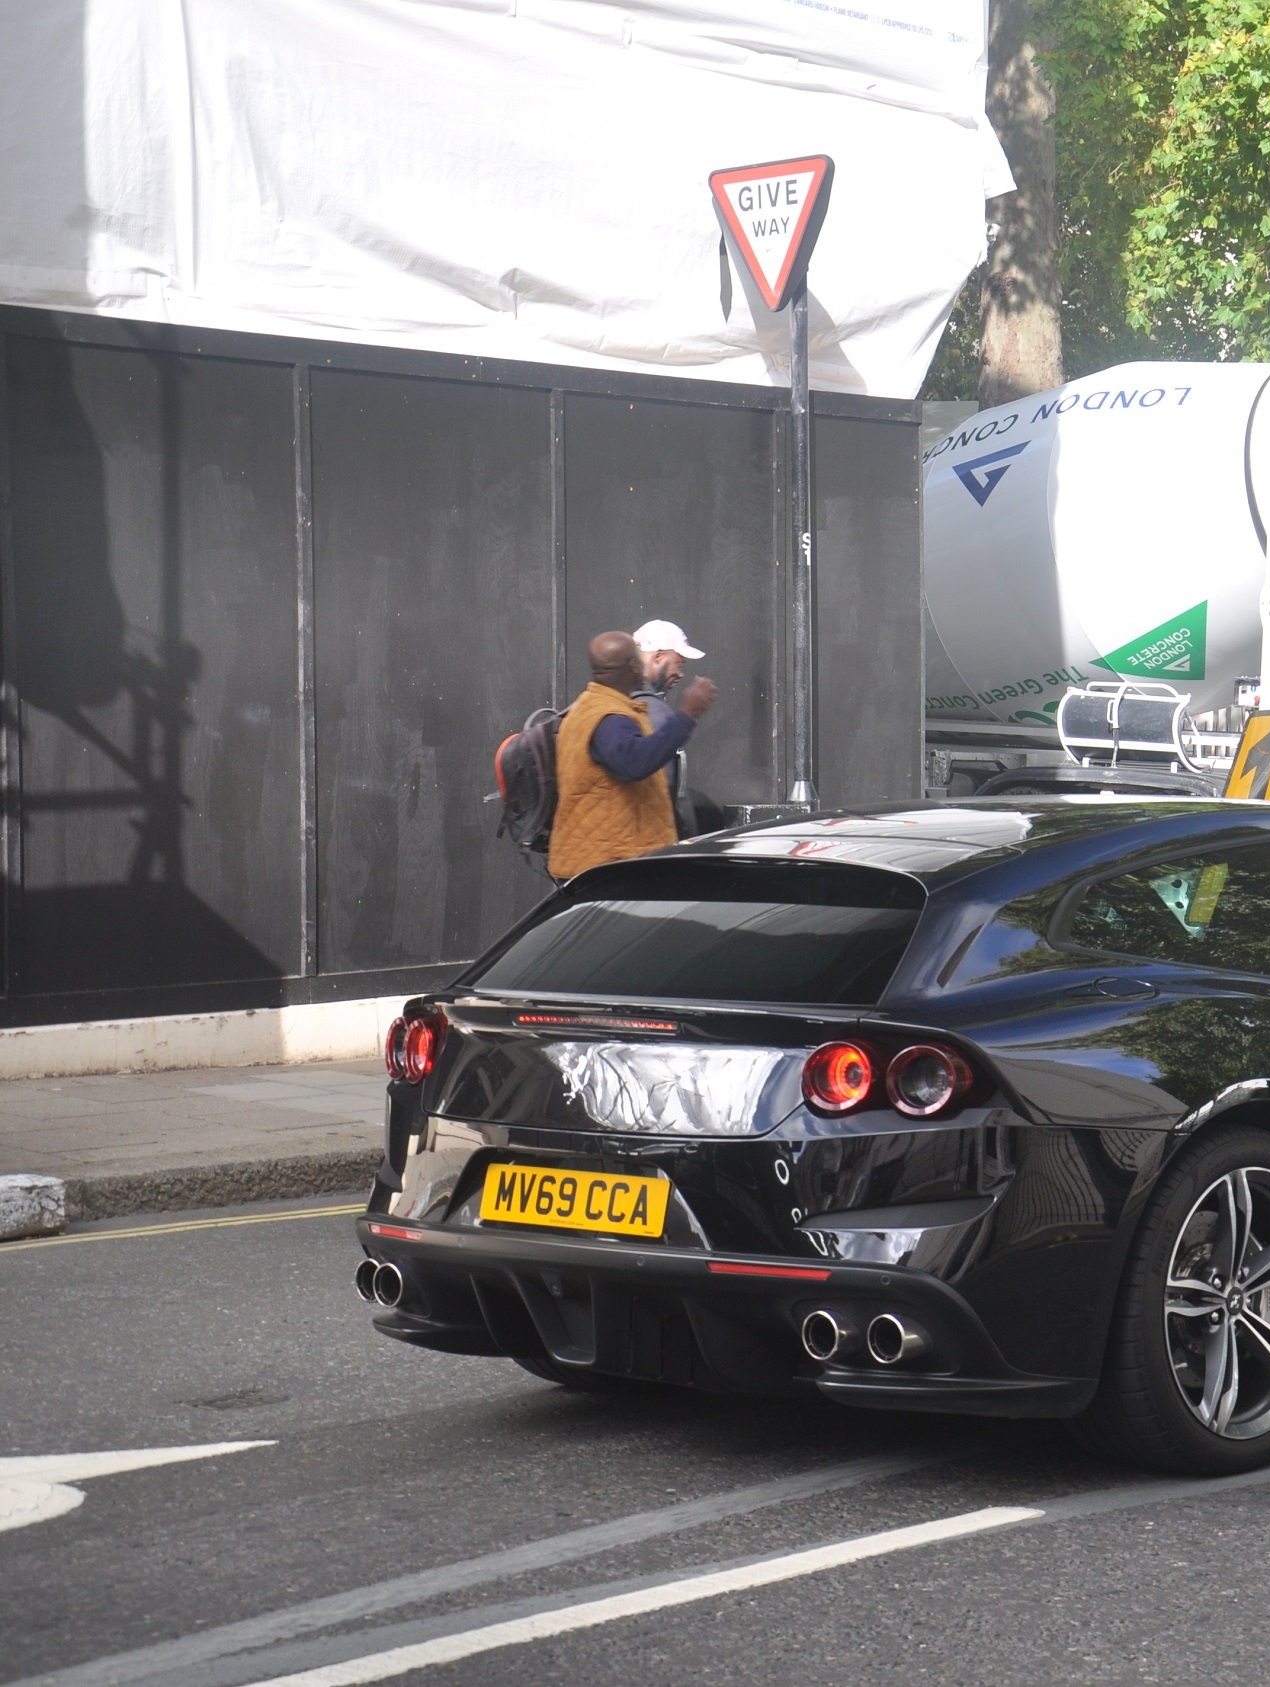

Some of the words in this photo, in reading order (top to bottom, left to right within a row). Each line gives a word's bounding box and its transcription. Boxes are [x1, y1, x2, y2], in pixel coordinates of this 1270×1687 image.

[738, 178, 799, 212] GIVE
[752, 216, 791, 238] WAY
[1030, 387, 1193, 424] LONDON
[1126, 627, 1192, 666] CONCRETE
[1144, 639, 1195, 670] LONDON
[1043, 665, 1090, 686] The
[977, 679, 1044, 705] Green
[494, 1170, 578, 1218] MV69
[585, 1179, 648, 1227] CCA
